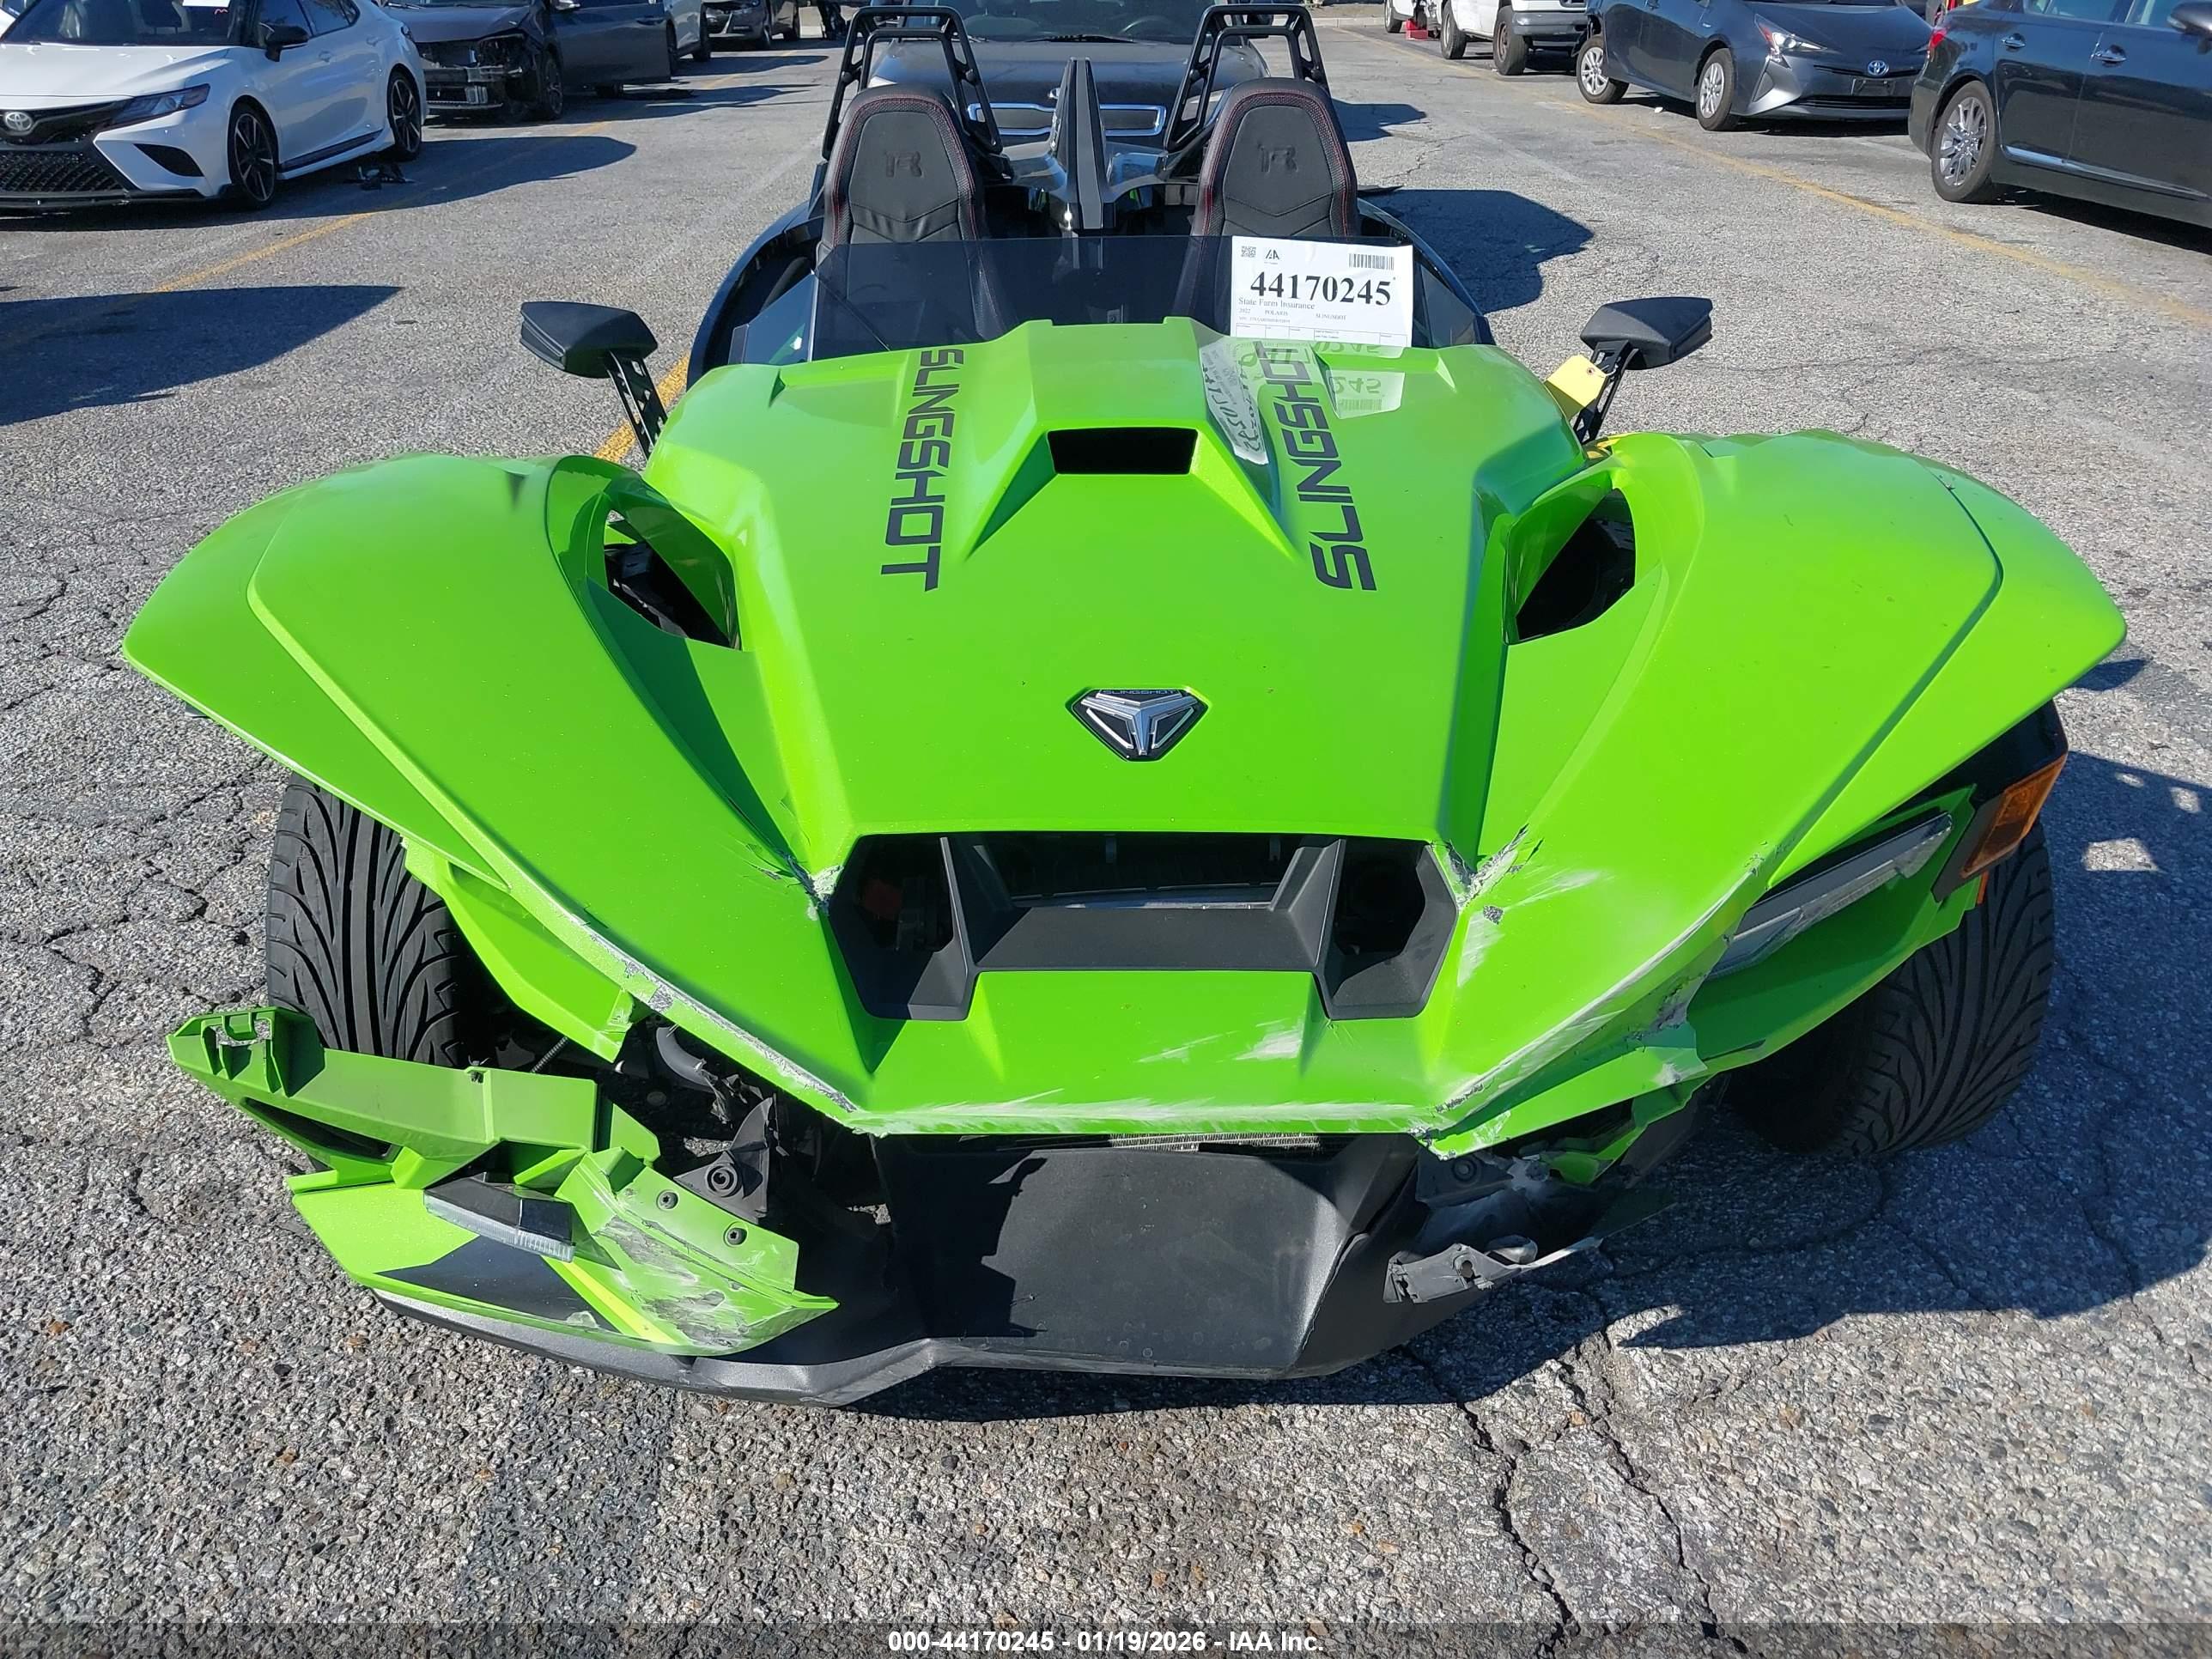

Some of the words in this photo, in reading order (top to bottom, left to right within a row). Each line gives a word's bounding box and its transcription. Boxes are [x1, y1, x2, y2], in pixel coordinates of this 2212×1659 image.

[1238, 297, 1257, 306] State
[1259, 298, 1278, 307] Farm
[1280, 300, 1316, 310] Insurance
[1250, 271, 1391, 306] 44170245
[881, 349, 964, 592] SLINGSHOT
[1255, 341, 1377, 592] SLINGSHOT
